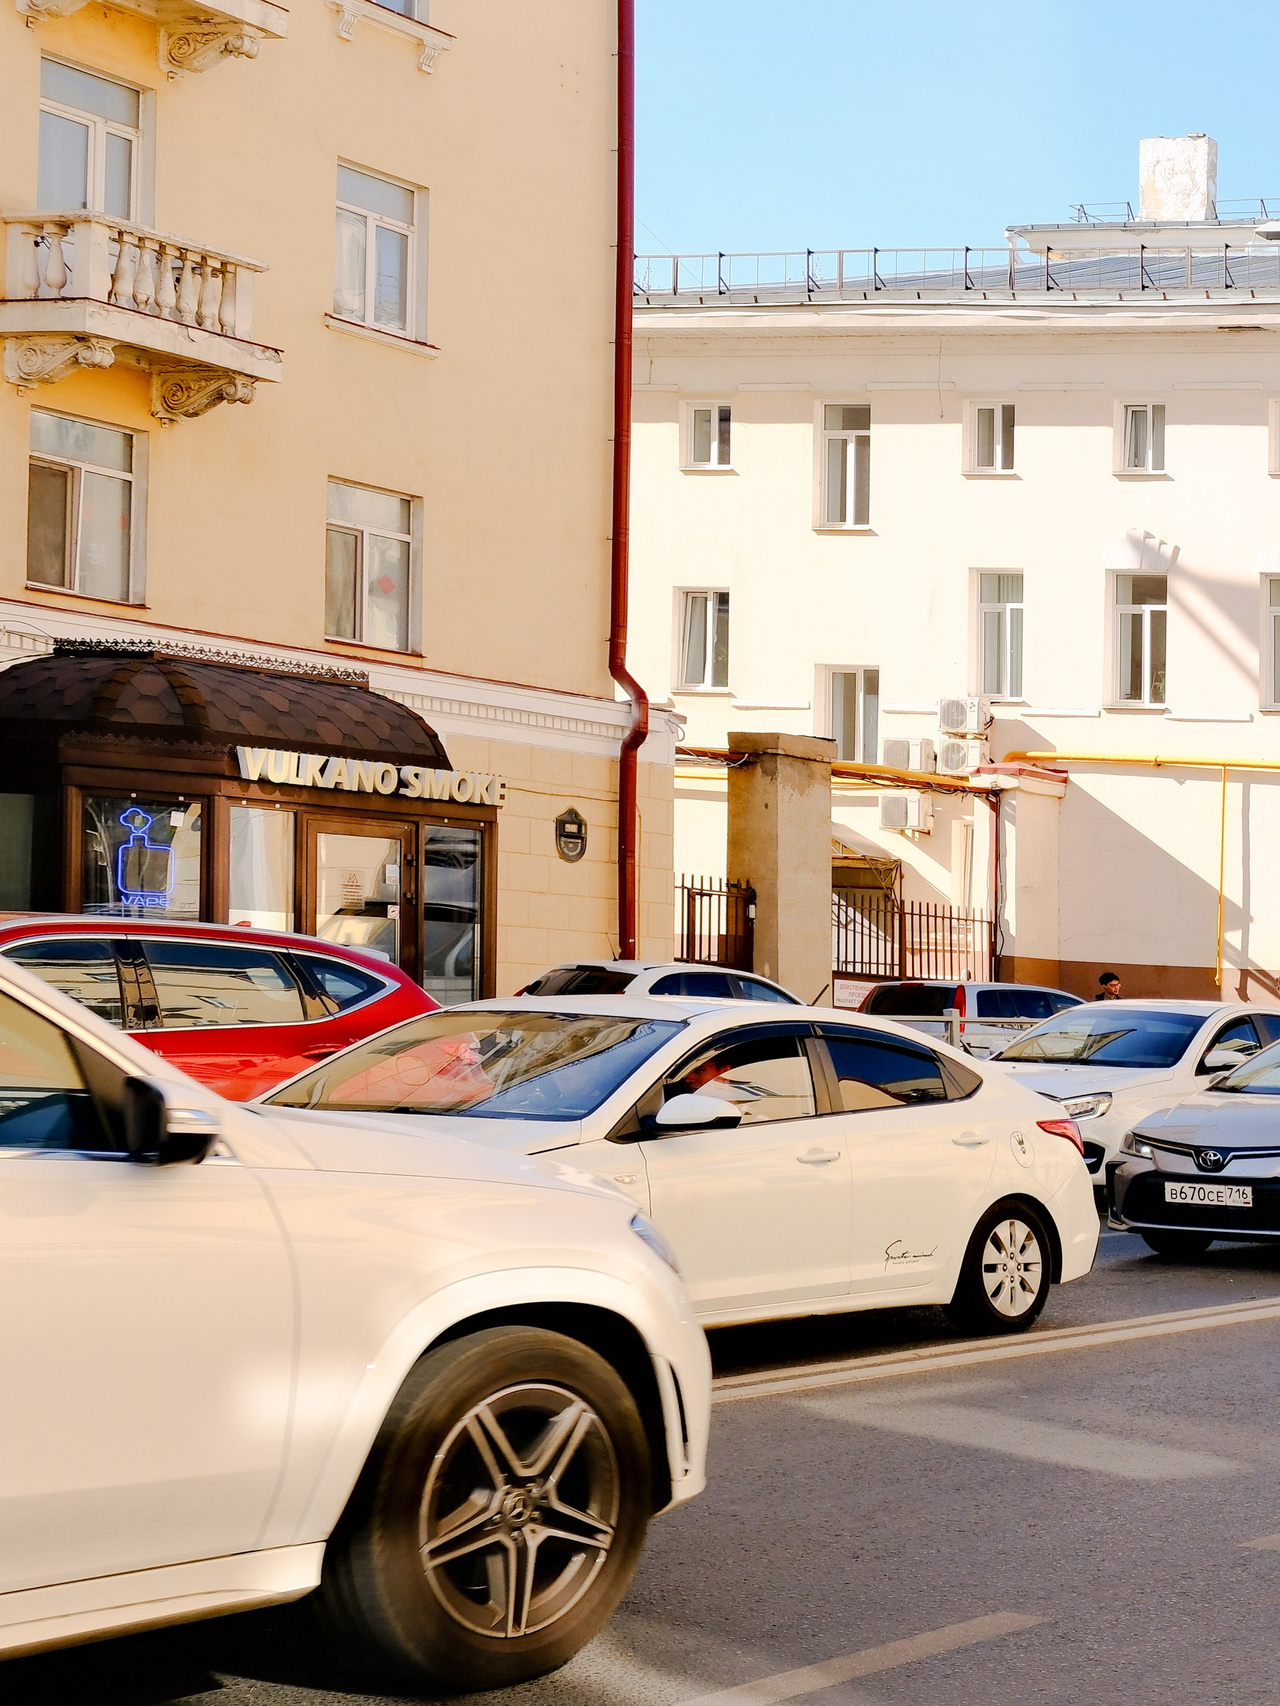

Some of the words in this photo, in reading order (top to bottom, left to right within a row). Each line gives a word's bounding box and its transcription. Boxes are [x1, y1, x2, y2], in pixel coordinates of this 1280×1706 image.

[236, 746, 398, 795] VULKANO
[400, 765, 509, 810] SMOKE
[121, 895, 171, 907] VAPE
[1170, 1185, 1224, 1203] В670СЕ
[1227, 1187, 1249, 1200] 716
